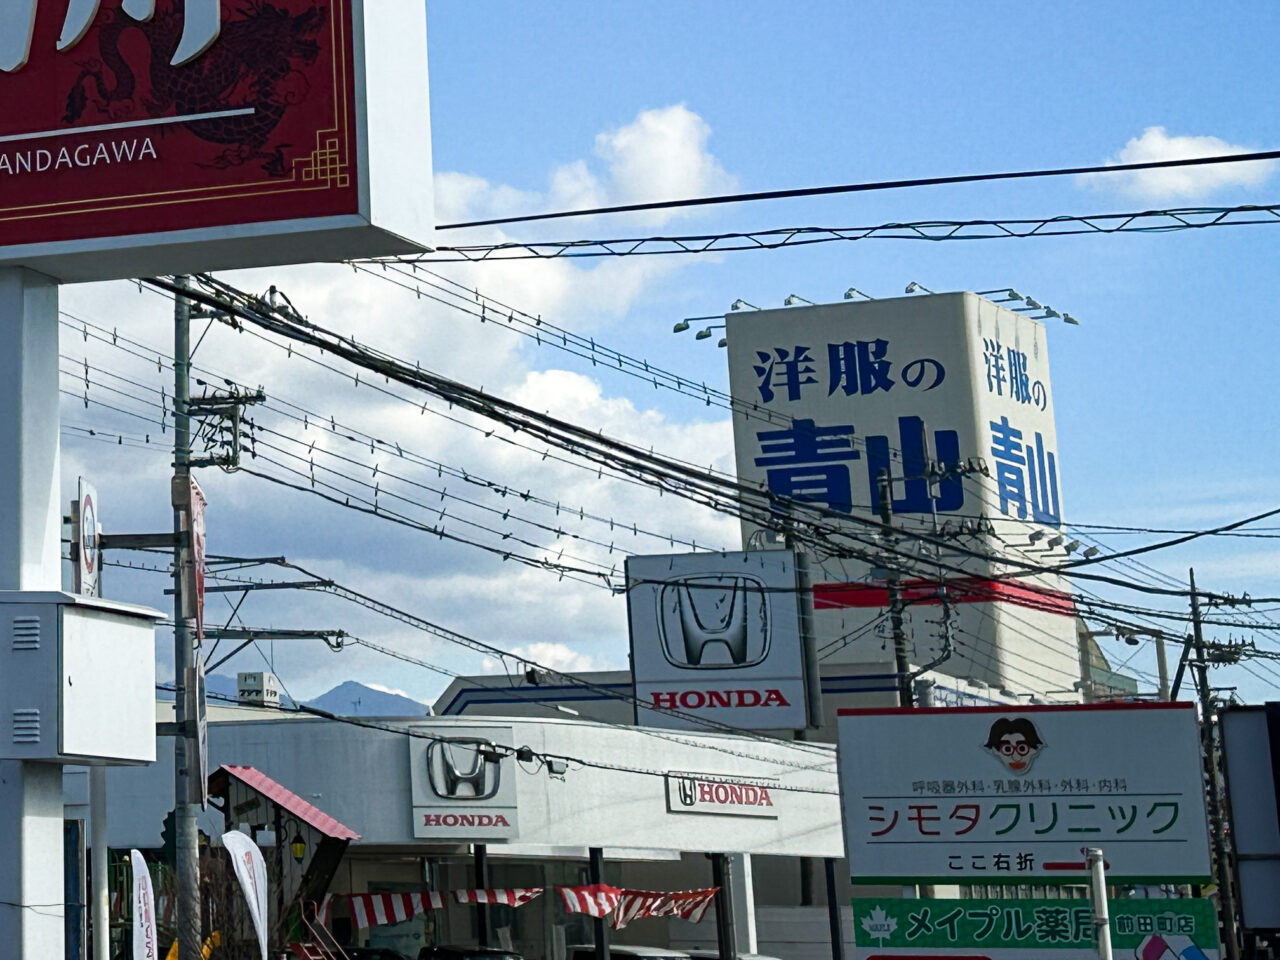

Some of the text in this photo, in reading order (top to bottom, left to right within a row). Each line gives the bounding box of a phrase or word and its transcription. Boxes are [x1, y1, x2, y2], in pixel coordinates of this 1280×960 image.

[753, 338, 946, 403] 洋服の
[983, 338, 1048, 412] 洋服の
[754, 416, 966, 530] 青山
[990, 416, 1061, 529] 青山
[650, 689, 791, 710] HONDA
[699, 781, 774, 807] HONDA
[424, 813, 511, 828] HONDA
[868, 802, 1179, 836] シモタクリニック
[948, 852, 1035, 871] ここ右折
